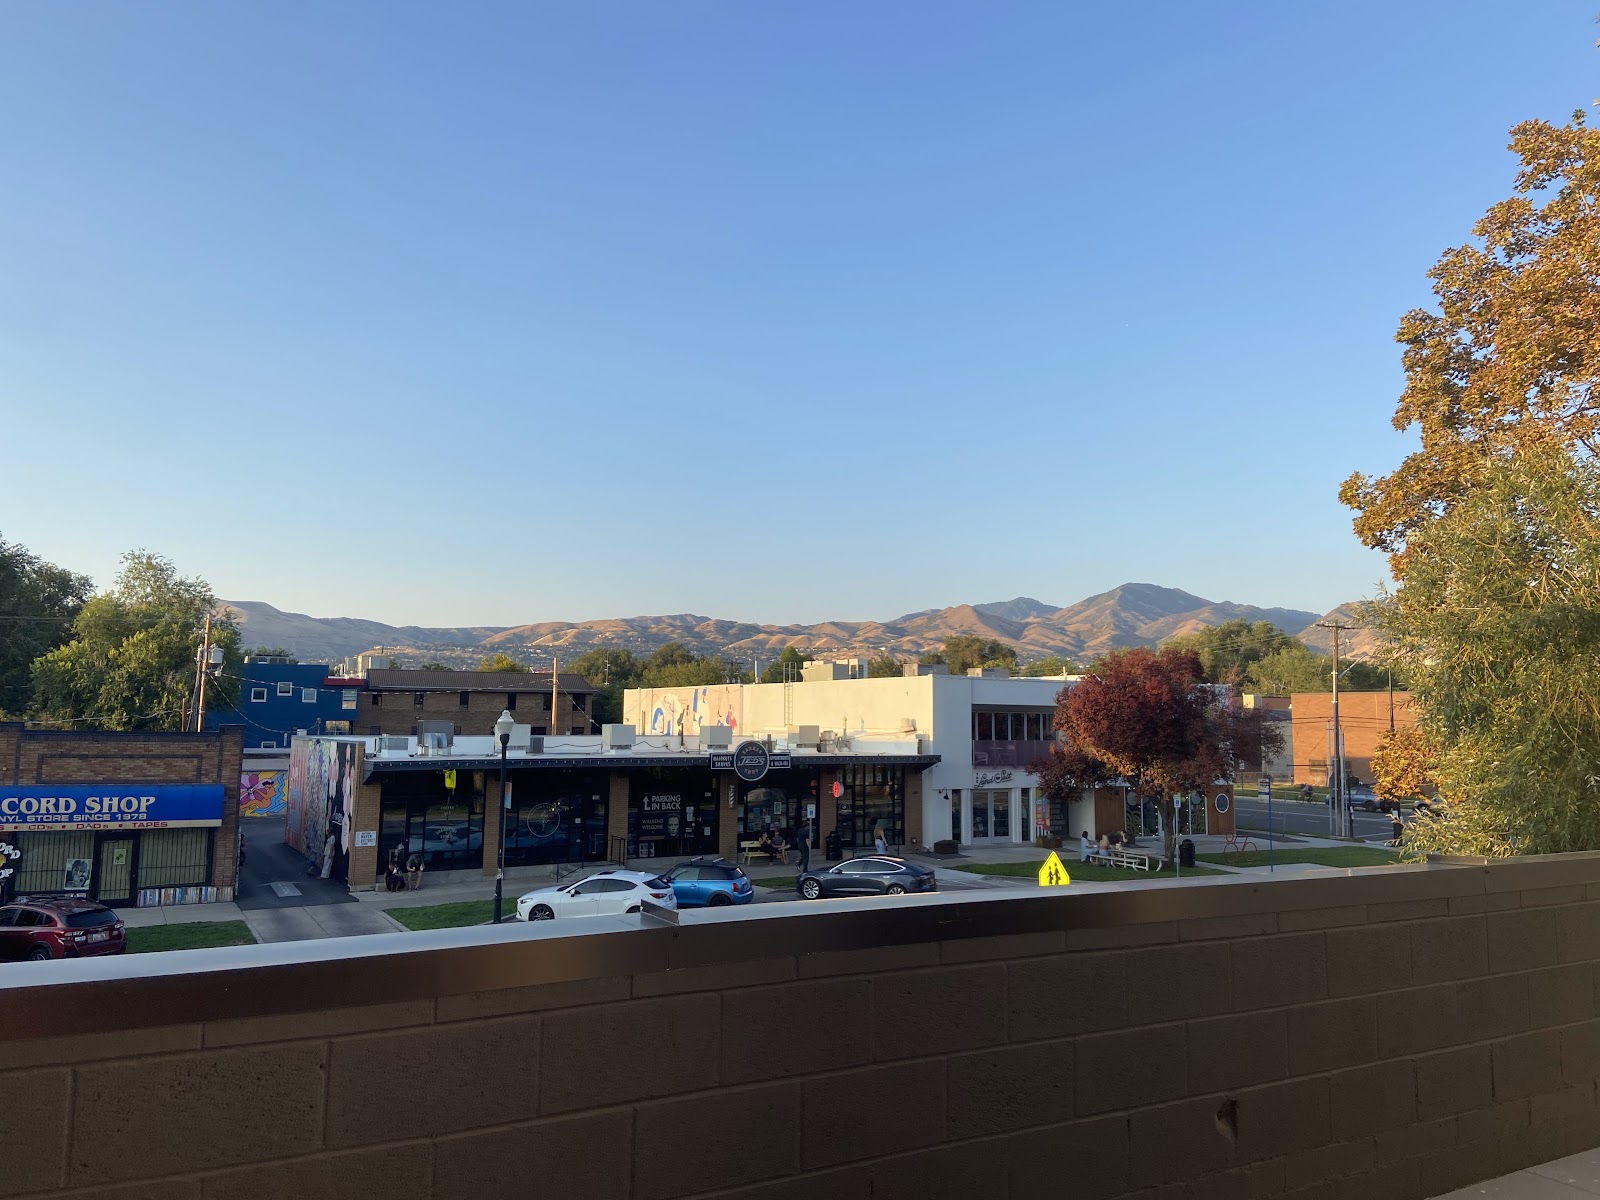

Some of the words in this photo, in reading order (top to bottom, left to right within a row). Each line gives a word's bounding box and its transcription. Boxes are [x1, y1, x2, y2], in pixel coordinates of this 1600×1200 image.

[742, 746, 763, 754] BARBER
[651, 794, 681, 803] PARKING
[0, 797, 77, 814] CORD
[84, 796, 156, 813] SHOP
[661, 802, 681, 810] BACK
[27, 814, 70, 822] STORE
[132, 821, 168, 829] TAPES
